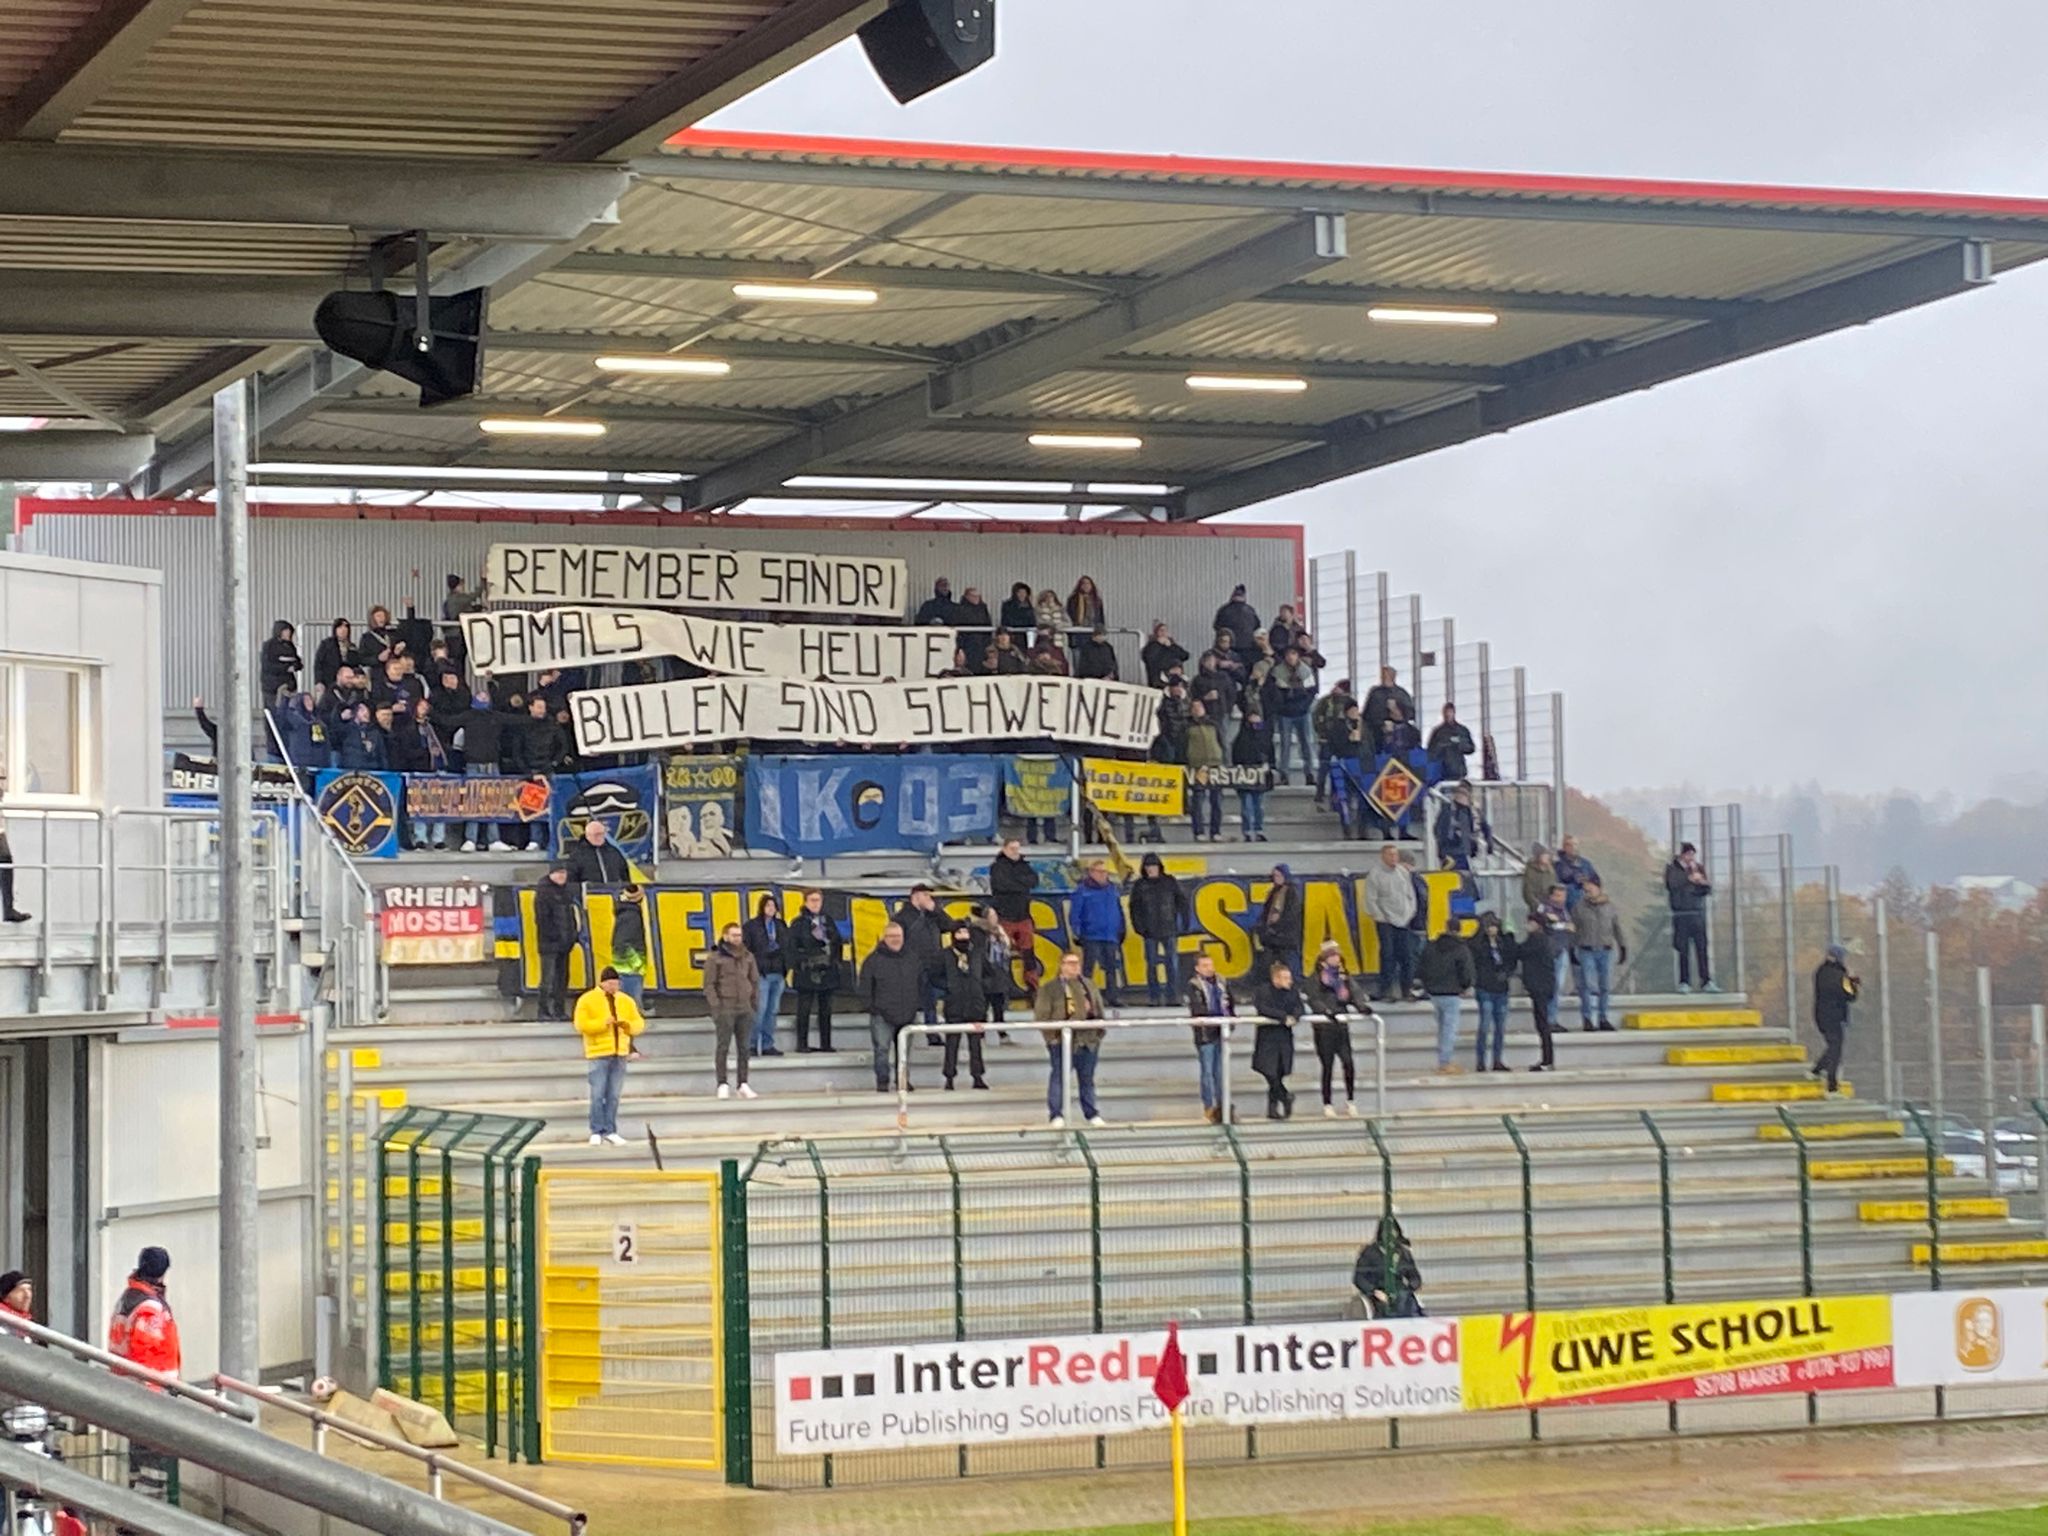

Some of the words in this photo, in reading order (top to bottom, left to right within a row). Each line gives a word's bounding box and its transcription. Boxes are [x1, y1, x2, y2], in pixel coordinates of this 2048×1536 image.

[503, 548, 739, 601] REMEMBER
[760, 557, 896, 610] SANDRI
[467, 612, 644, 668] DAMALS
[682, 617, 765, 674] WIE
[800, 627, 953, 679] HEUTE
[577, 683, 748, 747] BULLEN
[777, 682, 877, 737] SIND
[904, 680, 1157, 744] SCHWEINE!!!
[384, 886, 478, 908] RHEIN
[387, 910, 479, 933] MOSEL
[618, 1235, 633, 1262] 2
[895, 1339, 1130, 1395] InterRed
[1235, 1322, 1460, 1375] InterRed
[1550, 1329, 1655, 1373] UWE
[1669, 1302, 1833, 1357] SCHOLL
[789, 1418, 871, 1443] Future
[882, 1408, 1009, 1436] Publishing
[1019, 1402, 1133, 1428] Solutions
[1223, 1389, 1345, 1416] Publishing
[1354, 1382, 1461, 1409] Solutions
